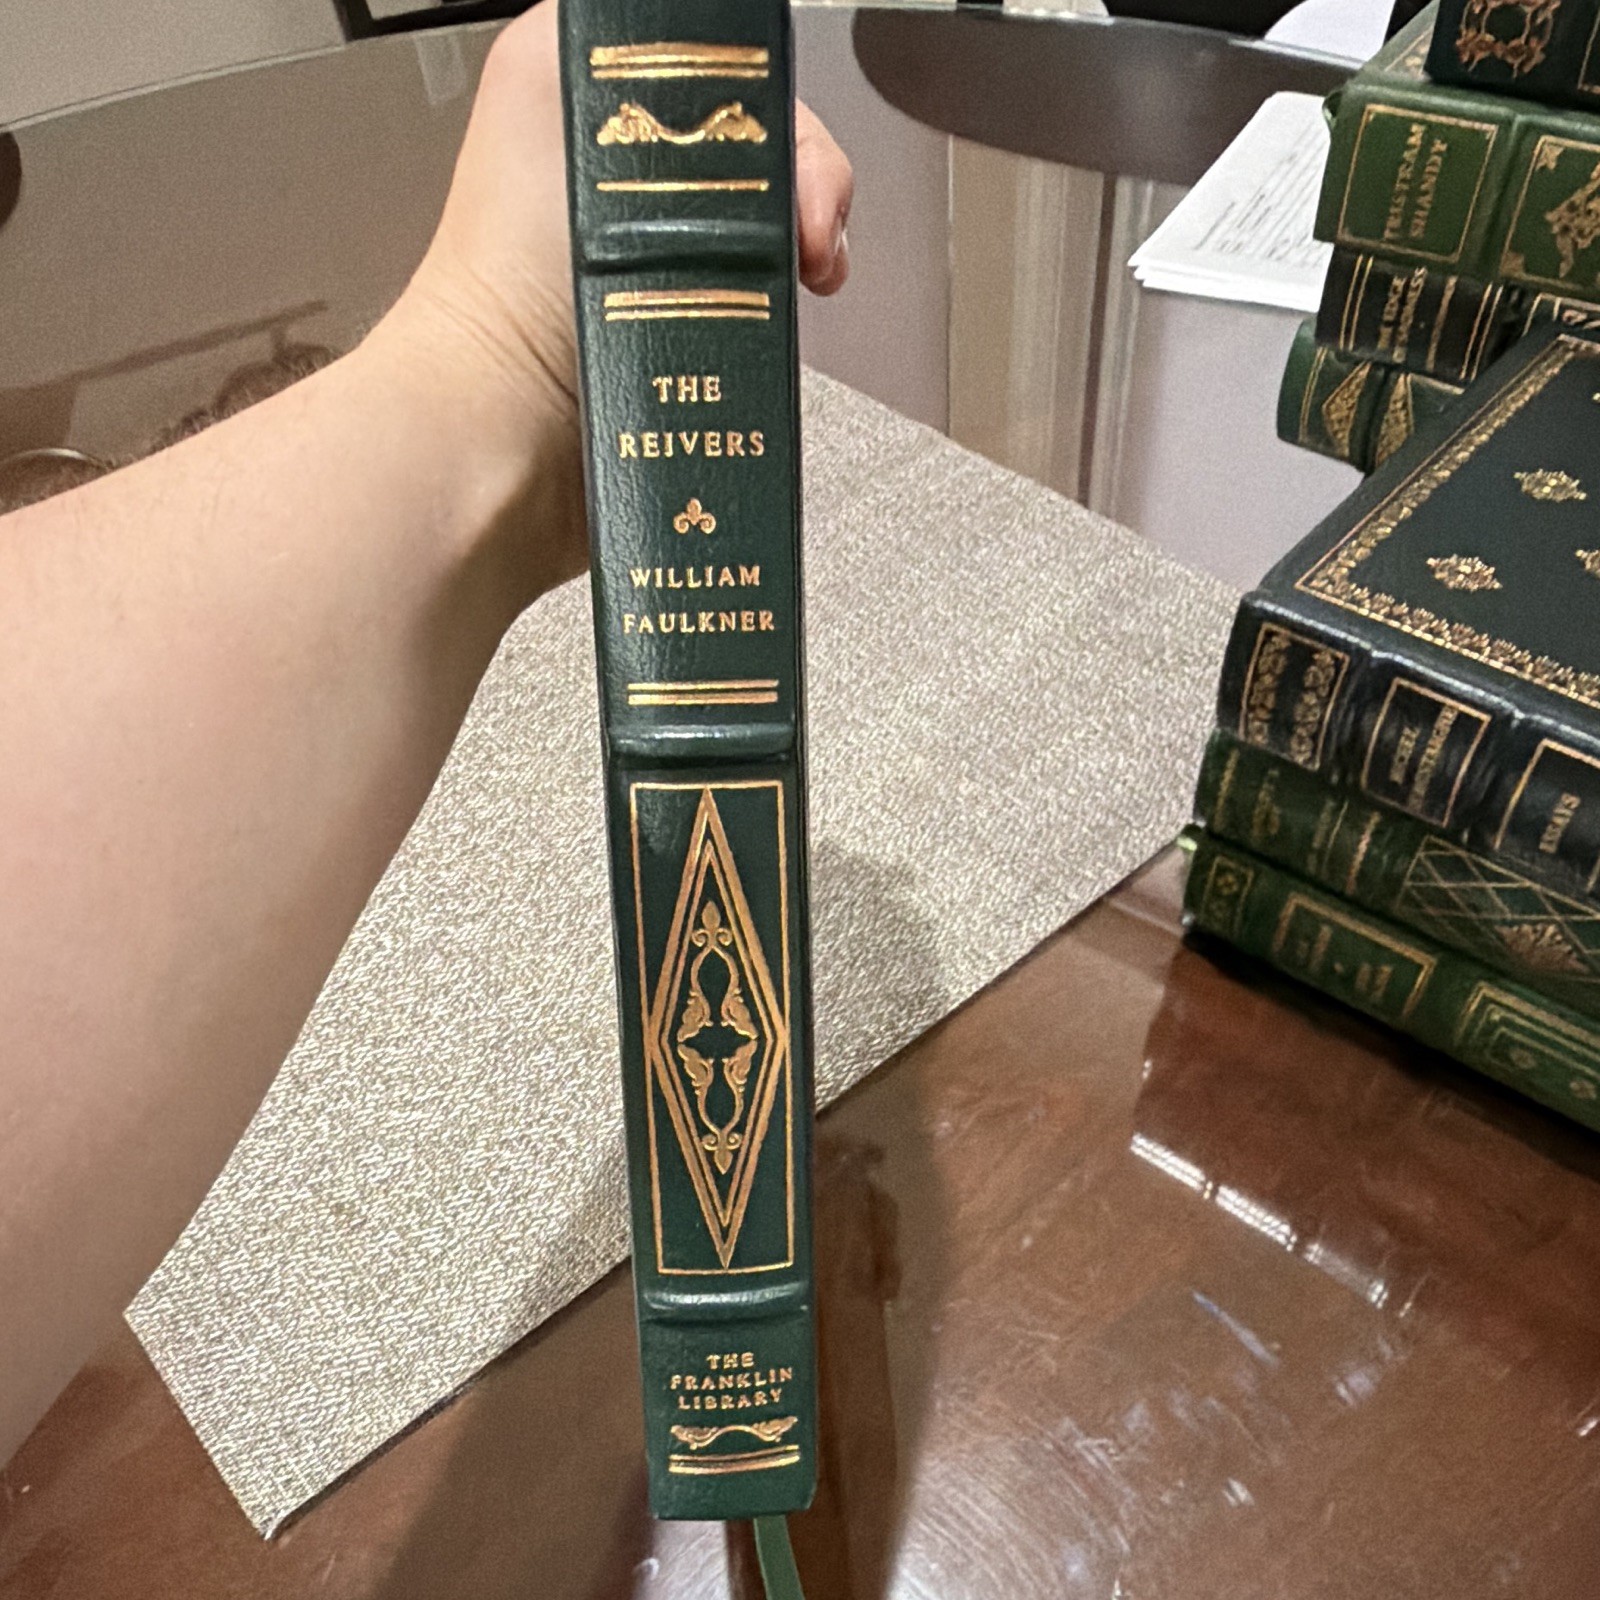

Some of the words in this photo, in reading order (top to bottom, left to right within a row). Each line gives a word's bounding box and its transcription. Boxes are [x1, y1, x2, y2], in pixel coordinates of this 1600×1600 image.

[1384, 123, 1426, 240] TRISTRAM
[1410, 139, 1448, 238] SHANDY
[652, 375, 722, 403] THE
[618, 430, 765, 459] REIVERS
[630, 565, 761, 589] WILLIAM
[623, 610, 775, 634] FAULKNER
[706, 1352, 755, 1369] THE
[670, 1367, 793, 1390] FRANKLIN
[678, 1388, 782, 1410] LIBRARY
